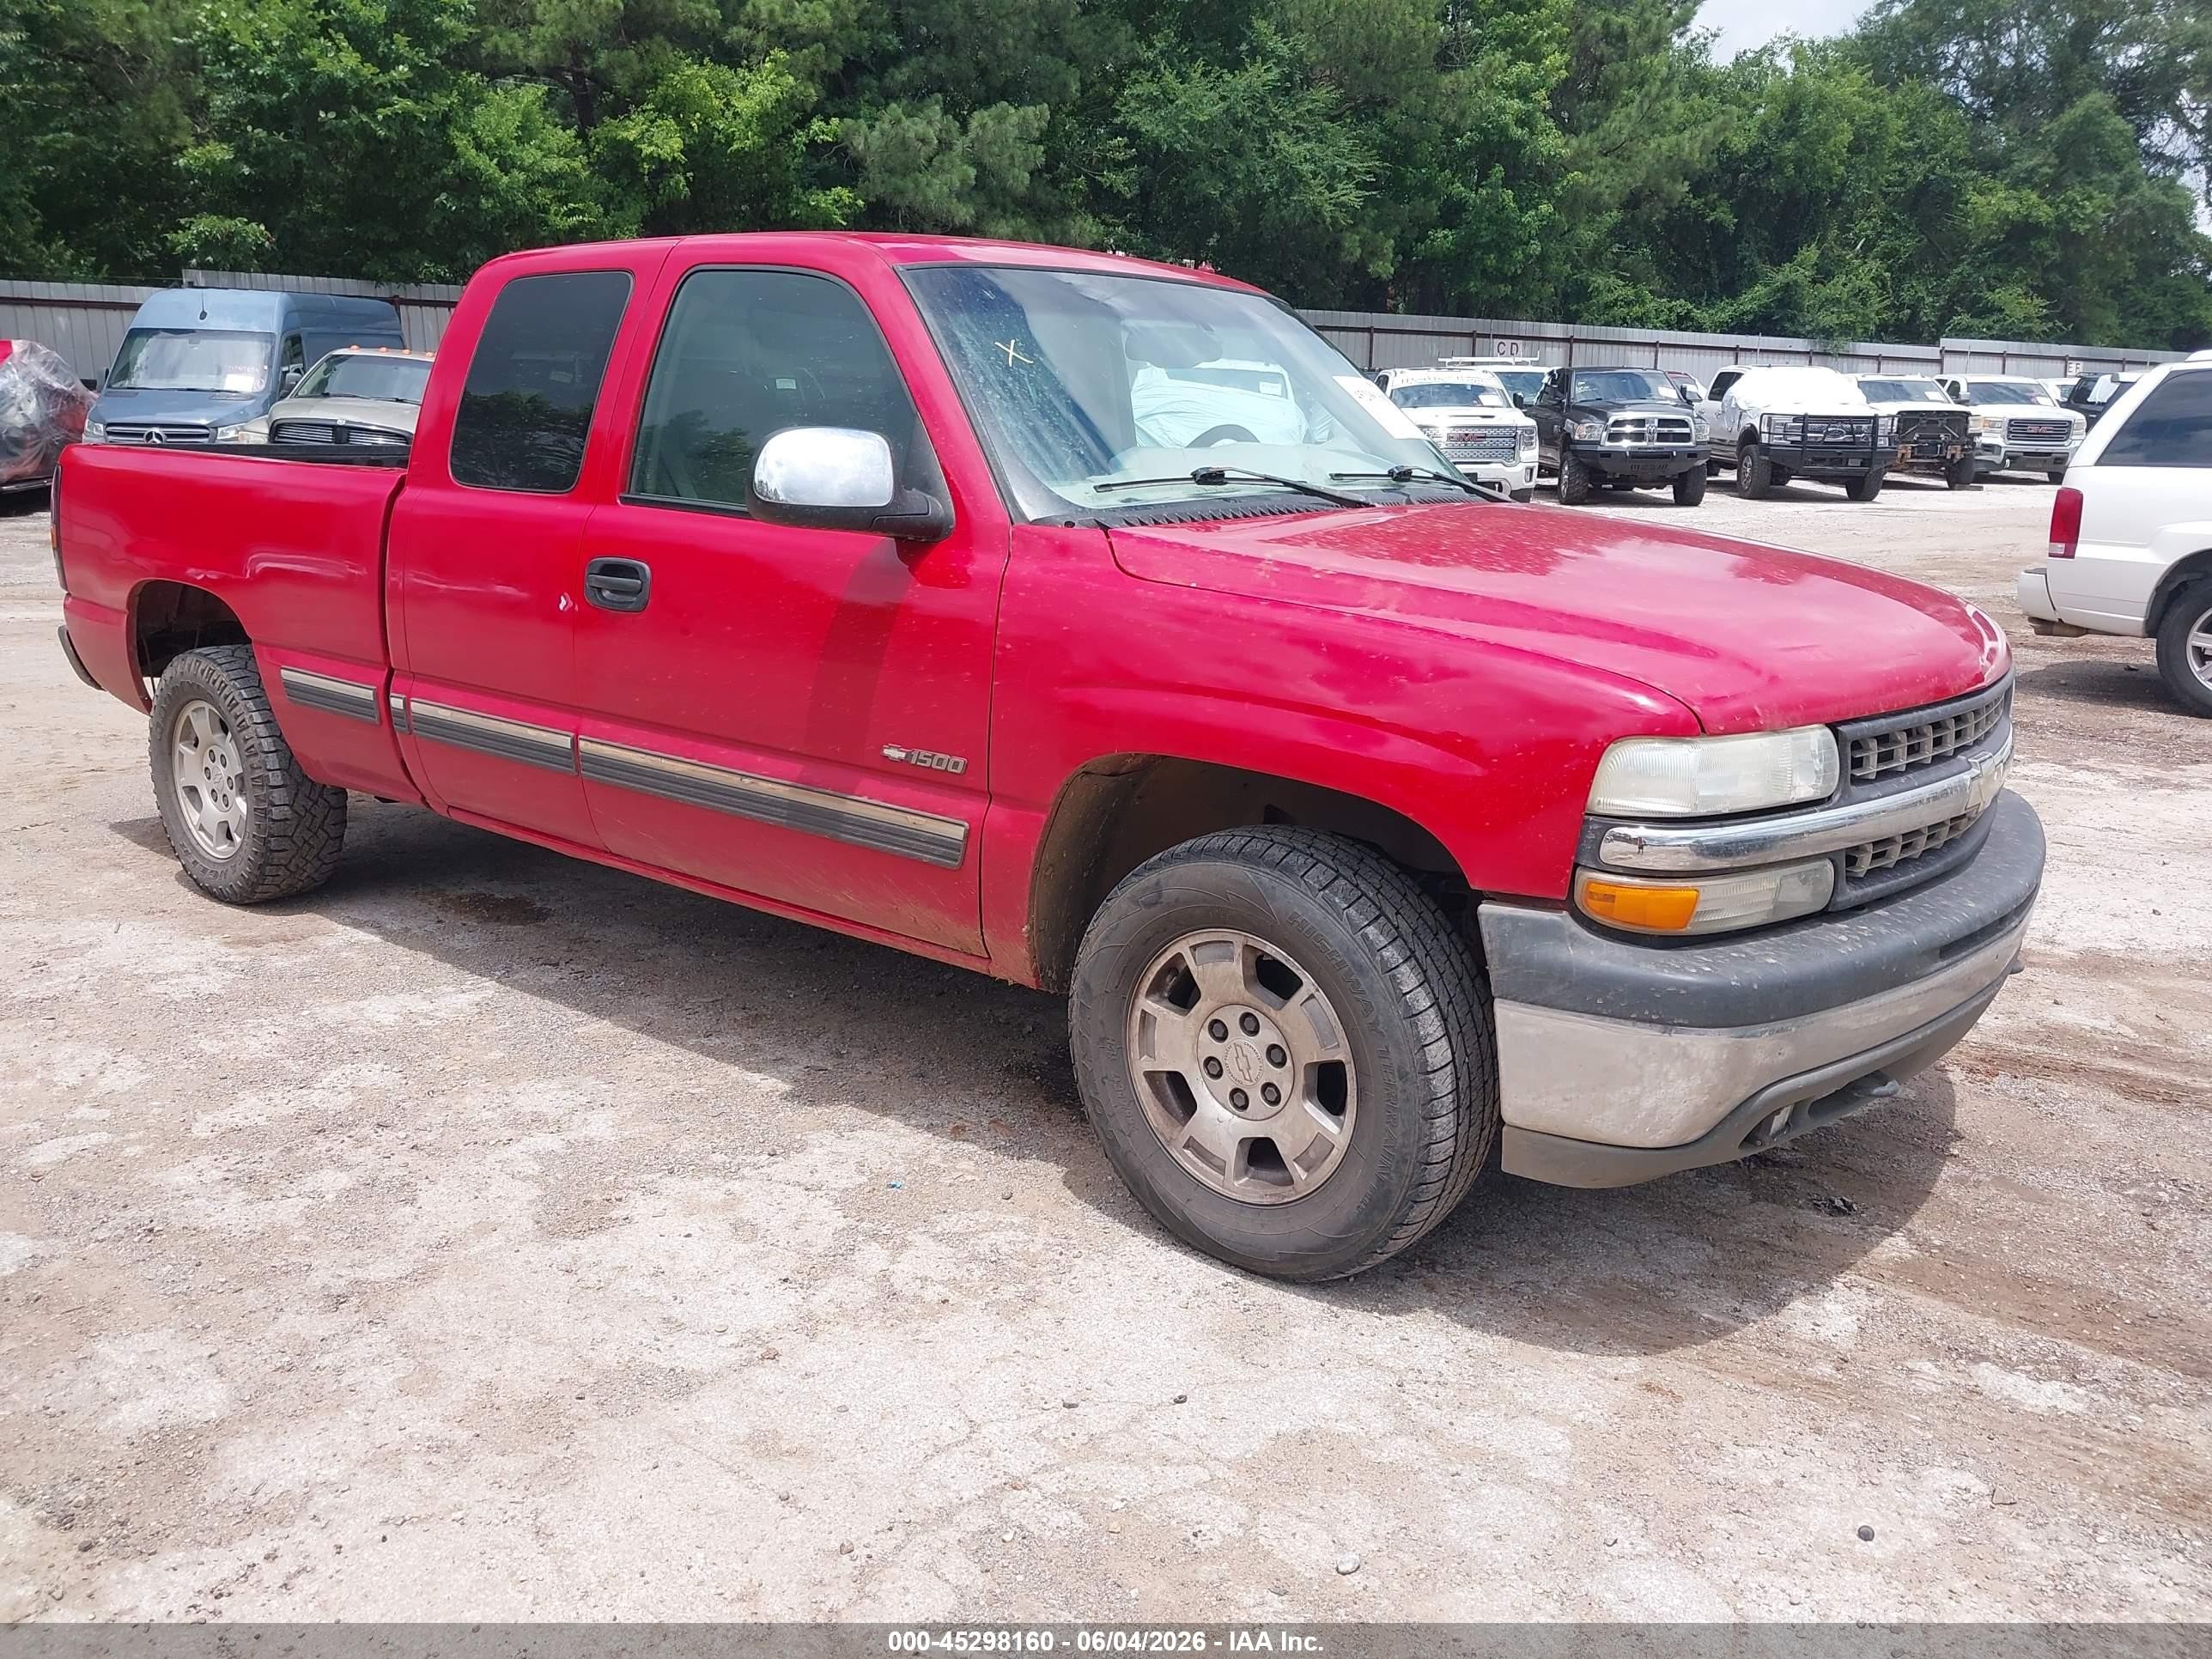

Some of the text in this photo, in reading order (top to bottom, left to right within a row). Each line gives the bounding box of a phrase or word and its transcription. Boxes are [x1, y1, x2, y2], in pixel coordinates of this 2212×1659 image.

[1448, 433, 1486, 441] GMC
[909, 749, 967, 774] 1500
[1288, 911, 1400, 1182] HIGHWAY TERRAIN
